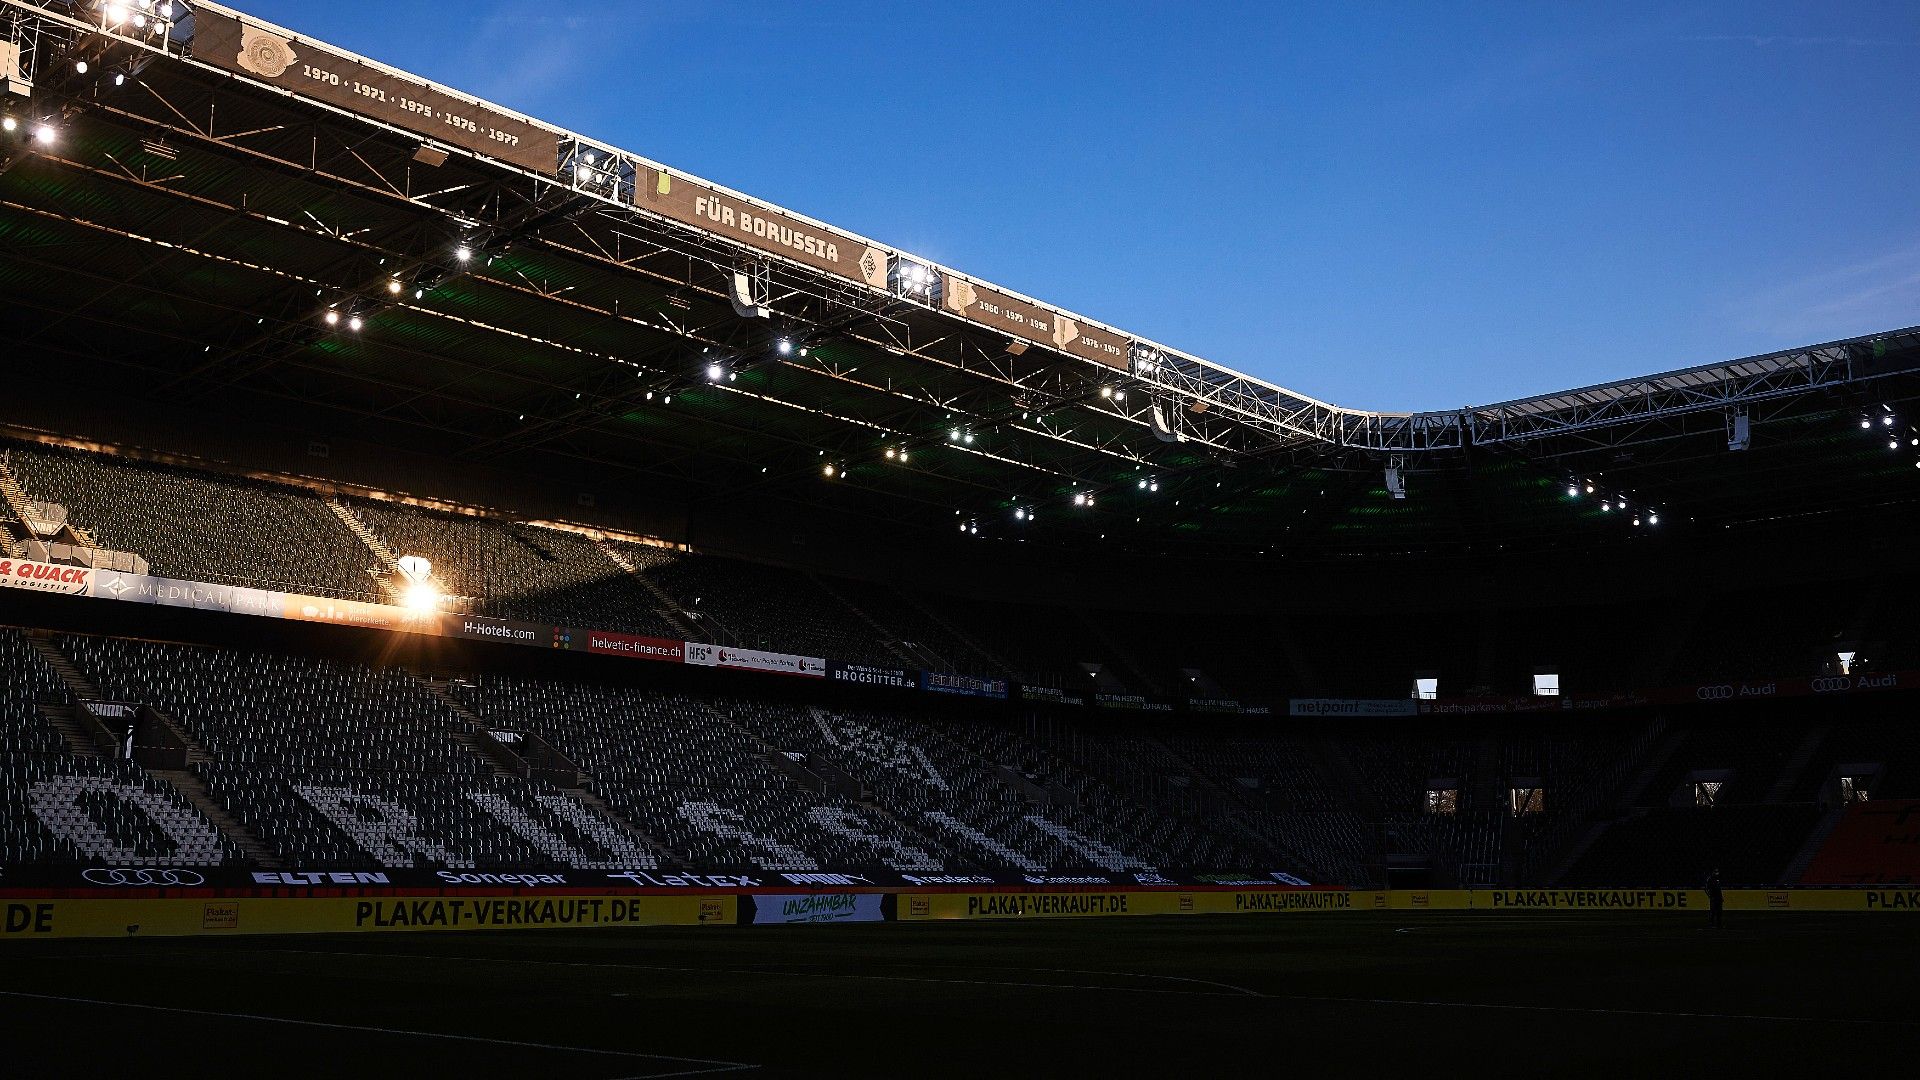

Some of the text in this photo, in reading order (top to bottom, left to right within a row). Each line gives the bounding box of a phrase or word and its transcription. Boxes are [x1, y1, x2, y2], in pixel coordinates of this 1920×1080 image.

[303, 64, 519, 147] 1970 1971 1975 1976 1977
[695, 196, 839, 262] FÜR BORUSSIA
[979, 301, 999, 315] 1960
[1005, 309, 1024, 323] 1973
[17, 563, 89, 584] QUACK
[14, 580, 69, 591] LOGISTIK
[138, 583, 280, 612] MEDICAL PARK
[464, 621, 535, 641] H-Hotels.com
[591, 636, 681, 658] helvetic-finance.ch
[1740, 683, 1776, 696] Audi
[1857, 674, 1897, 687] Audi
[1297, 701, 1360, 714] netpoint
[251, 872, 390, 885] ELTEN
[436, 871, 567, 887] Sonepar
[968, 895, 1128, 916] PLAKAT-VERKAUFT.DE
[1236, 892, 1350, 911] PLAKAT-VERKAUFT.DE
[1493, 892, 1688, 909] PLAKAT-VERKAUFT.DE
[357, 899, 641, 927] PLAKAT-VERKAUFT.DE
